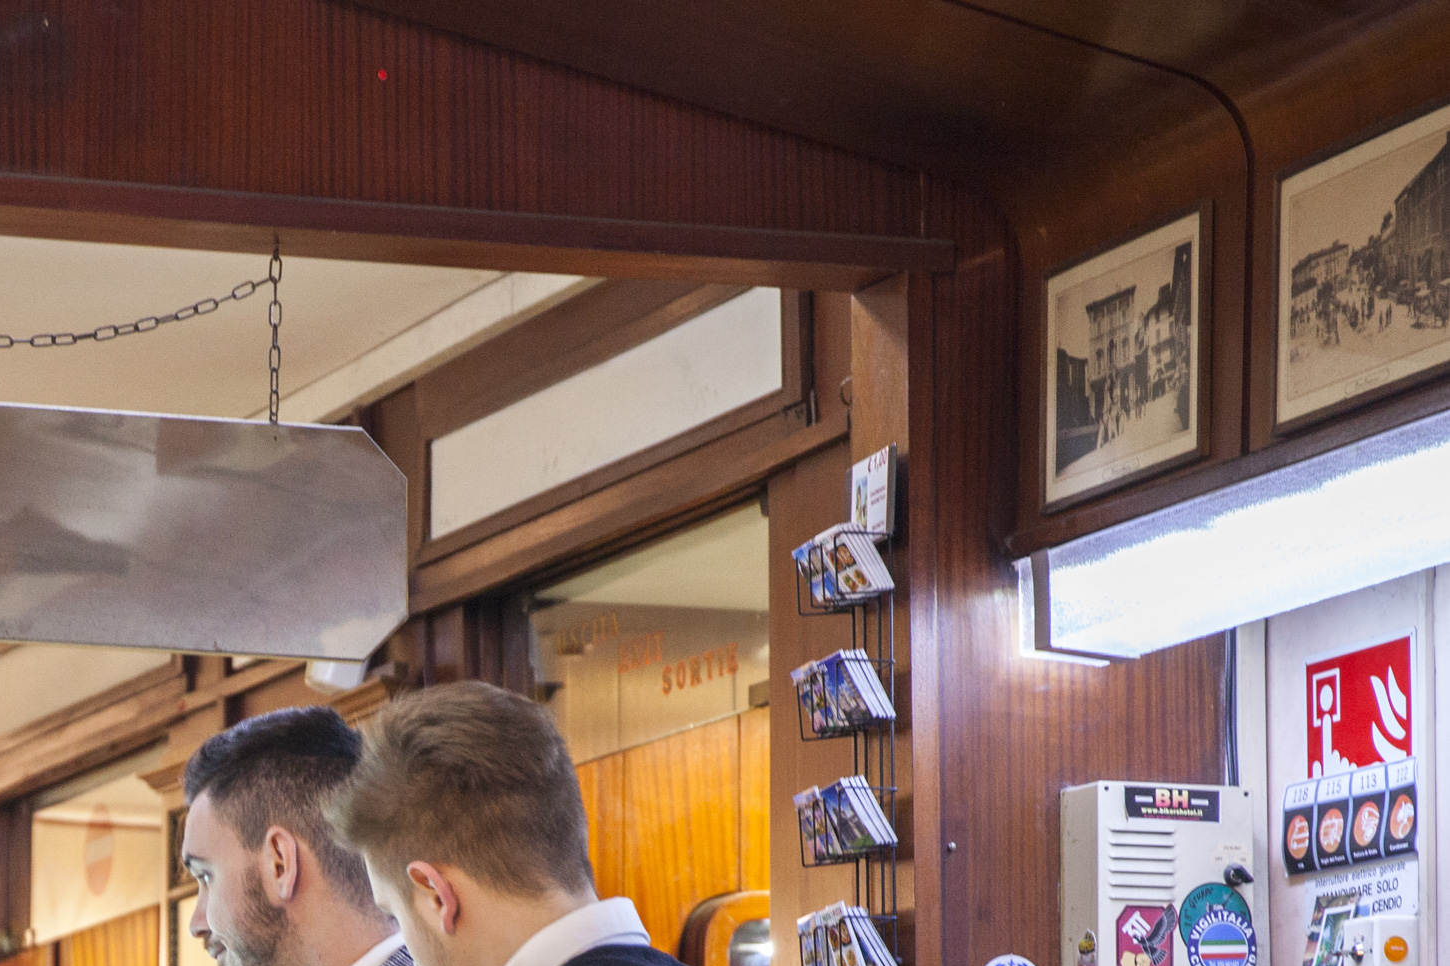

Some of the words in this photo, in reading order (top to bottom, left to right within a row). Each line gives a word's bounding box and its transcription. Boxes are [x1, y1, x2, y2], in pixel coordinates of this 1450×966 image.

[661, 642, 739, 695] SORTIE
[1292, 787, 1309, 803] 118
[1326, 780, 1342, 796] 115
[1360, 773, 1377, 790] 113
[1396, 766, 1409, 783] 112
[1155, 788, 1189, 809] BH
[1376, 877, 1399, 894] SOLO
[1372, 895, 1403, 914] CENDIO
[1190, 910, 1254, 940] VIGILITALIA
